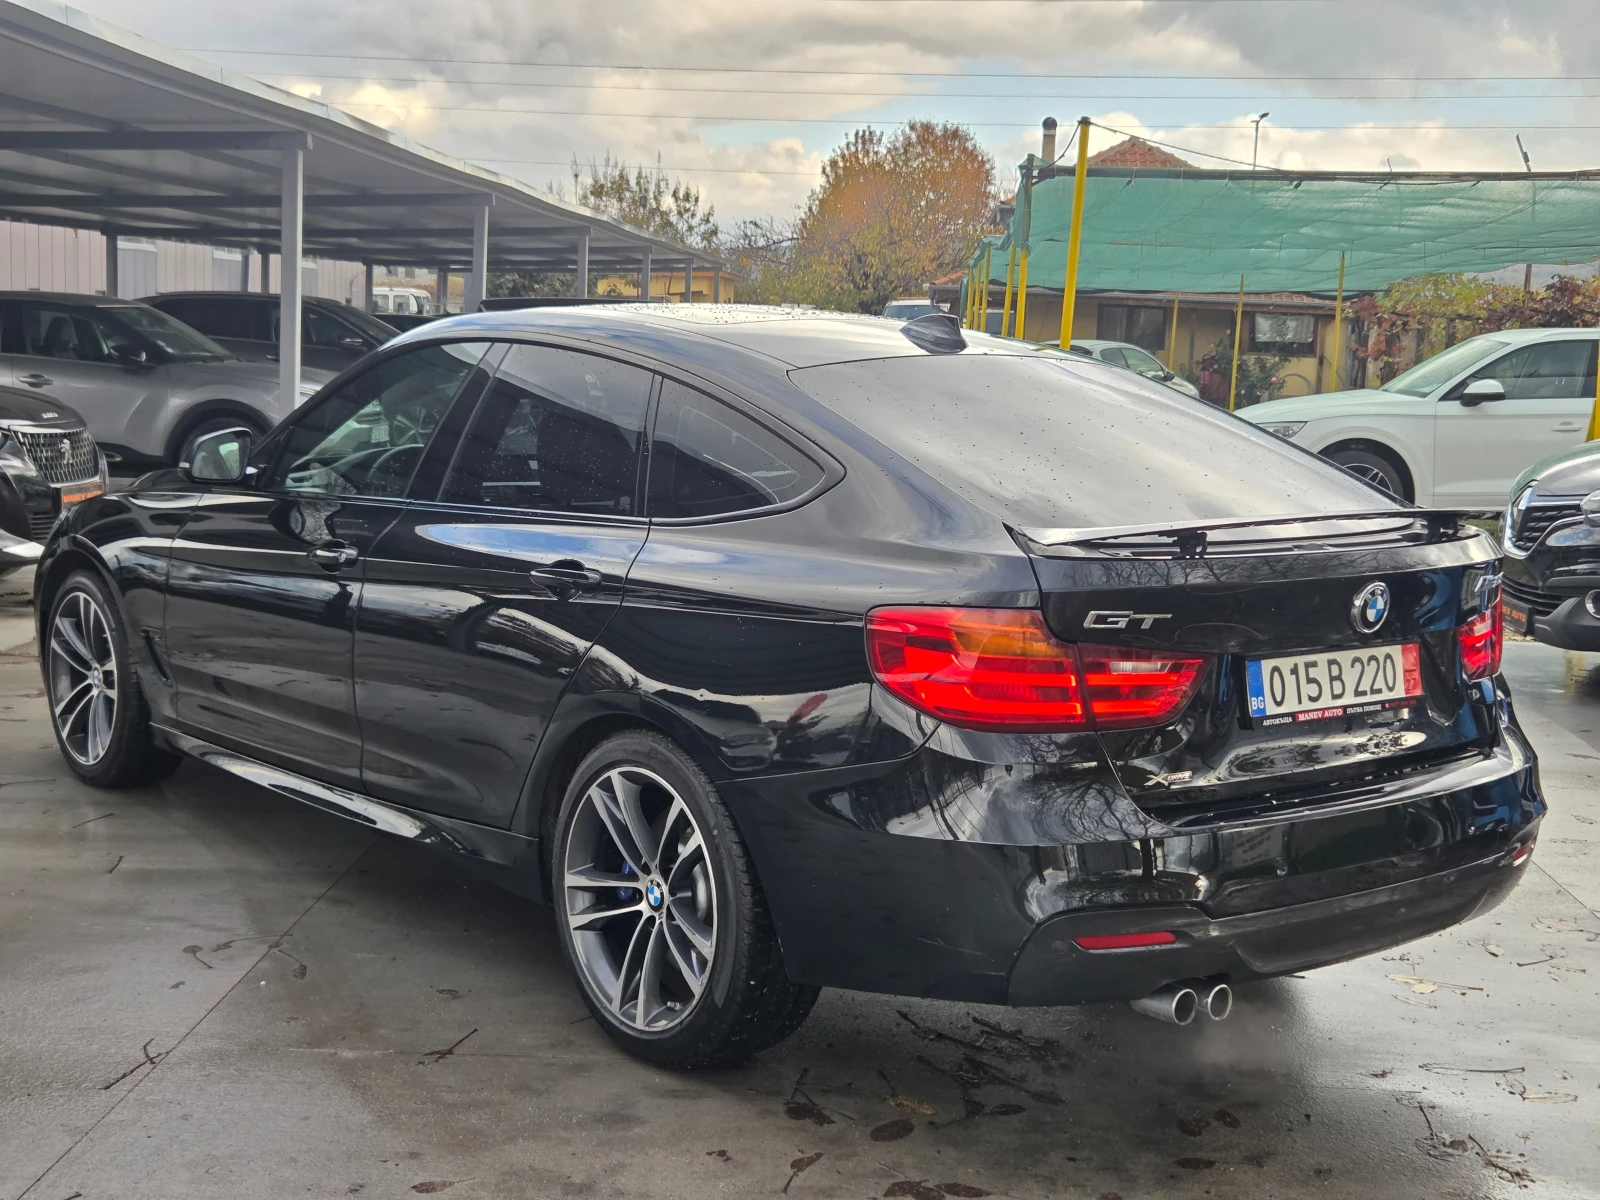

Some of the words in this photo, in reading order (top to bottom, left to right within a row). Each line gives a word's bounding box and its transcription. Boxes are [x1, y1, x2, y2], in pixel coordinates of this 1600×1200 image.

[1083, 610, 1173, 630] GT
[1251, 696, 1265, 710] BG
[1298, 710, 1323, 721] MANEV
[1324, 708, 1343, 718] AUTO
